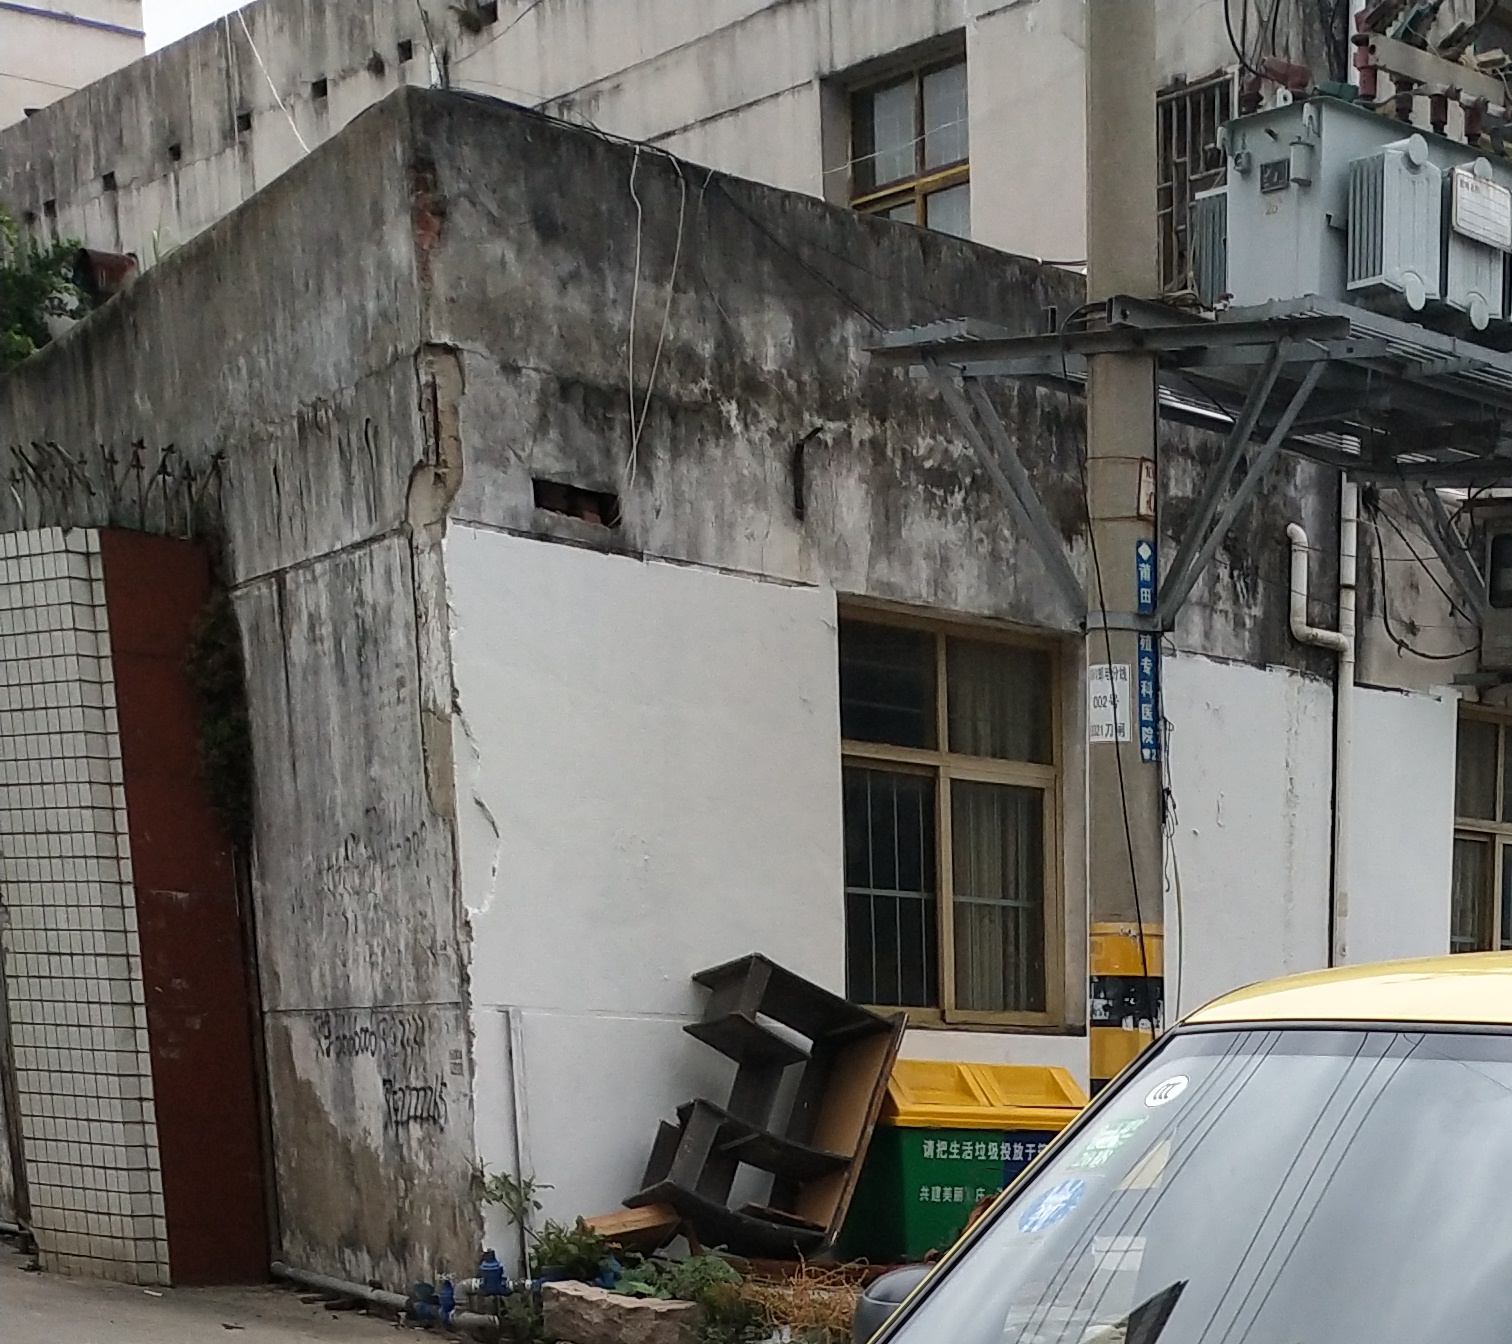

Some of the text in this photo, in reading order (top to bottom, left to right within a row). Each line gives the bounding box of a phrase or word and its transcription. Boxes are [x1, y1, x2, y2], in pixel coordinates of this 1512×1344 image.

[919, 1185, 985, 1203] 共建美丽庄
